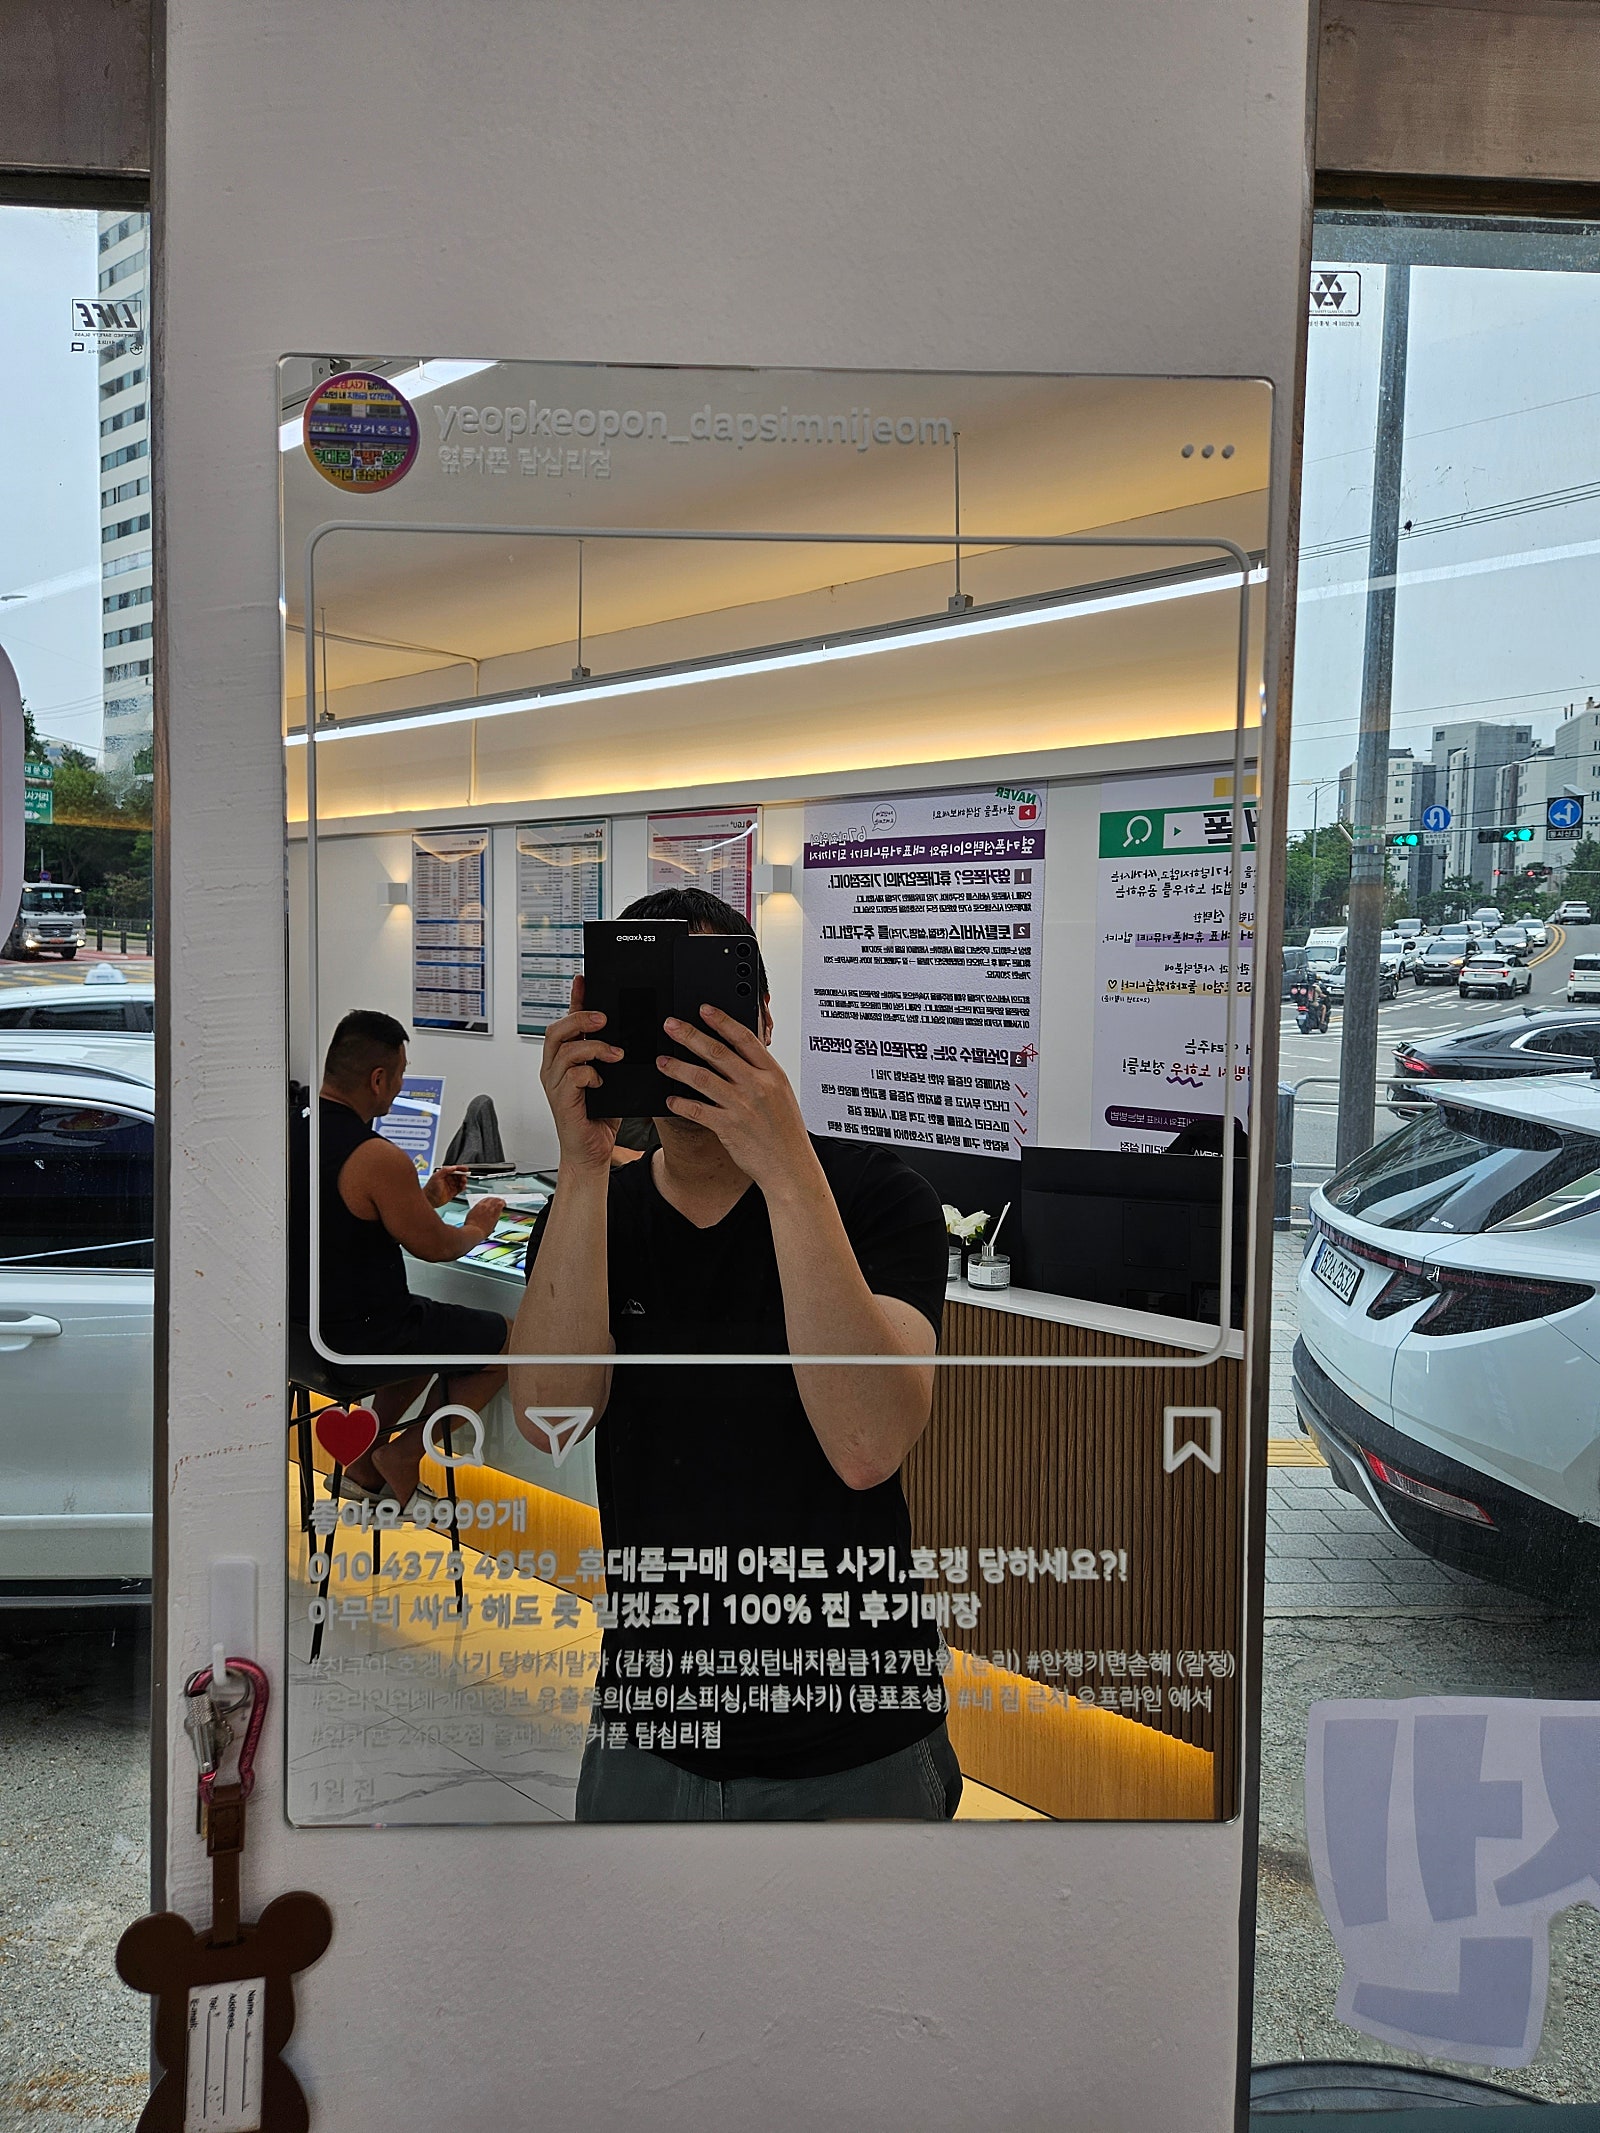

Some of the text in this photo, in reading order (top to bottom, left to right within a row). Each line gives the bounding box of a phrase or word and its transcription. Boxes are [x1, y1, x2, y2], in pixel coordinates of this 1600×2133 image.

[433, 399, 953, 452] yeopkeopon_dapsimnijeom
[438, 446, 611, 480] 옆커폰 답십리점
[24, 790, 49, 802] 사거리
[308, 1498, 527, 1535] 좋아요 9999개
[308, 1546, 1127, 1583] 010 4375 4959_휴대폰구매 아직도 사기,호갱 당하세요?!
[308, 1591, 982, 1630] 아무리 싸다 해도 못 믿겠죠?! 100% 찐 후기매장
[500, 1649, 609, 1679] 당하지말자
[616, 1648, 673, 1678] (감정)
[1026, 1649, 1172, 1678] #안챙기면손해
[1175, 1649, 1236, 1678] (감정)
[849, 1684, 949, 1714] (공포조성)
[957, 1686, 994, 1713] #내
[1002, 1686, 1021, 1713] 집
[1077, 1686, 1162, 1713] 오프라인
[1168, 1685, 1213, 1713] 에서
[636, 1720, 721, 1750] 답십리점
[354, 1777, 376, 1804] 전
